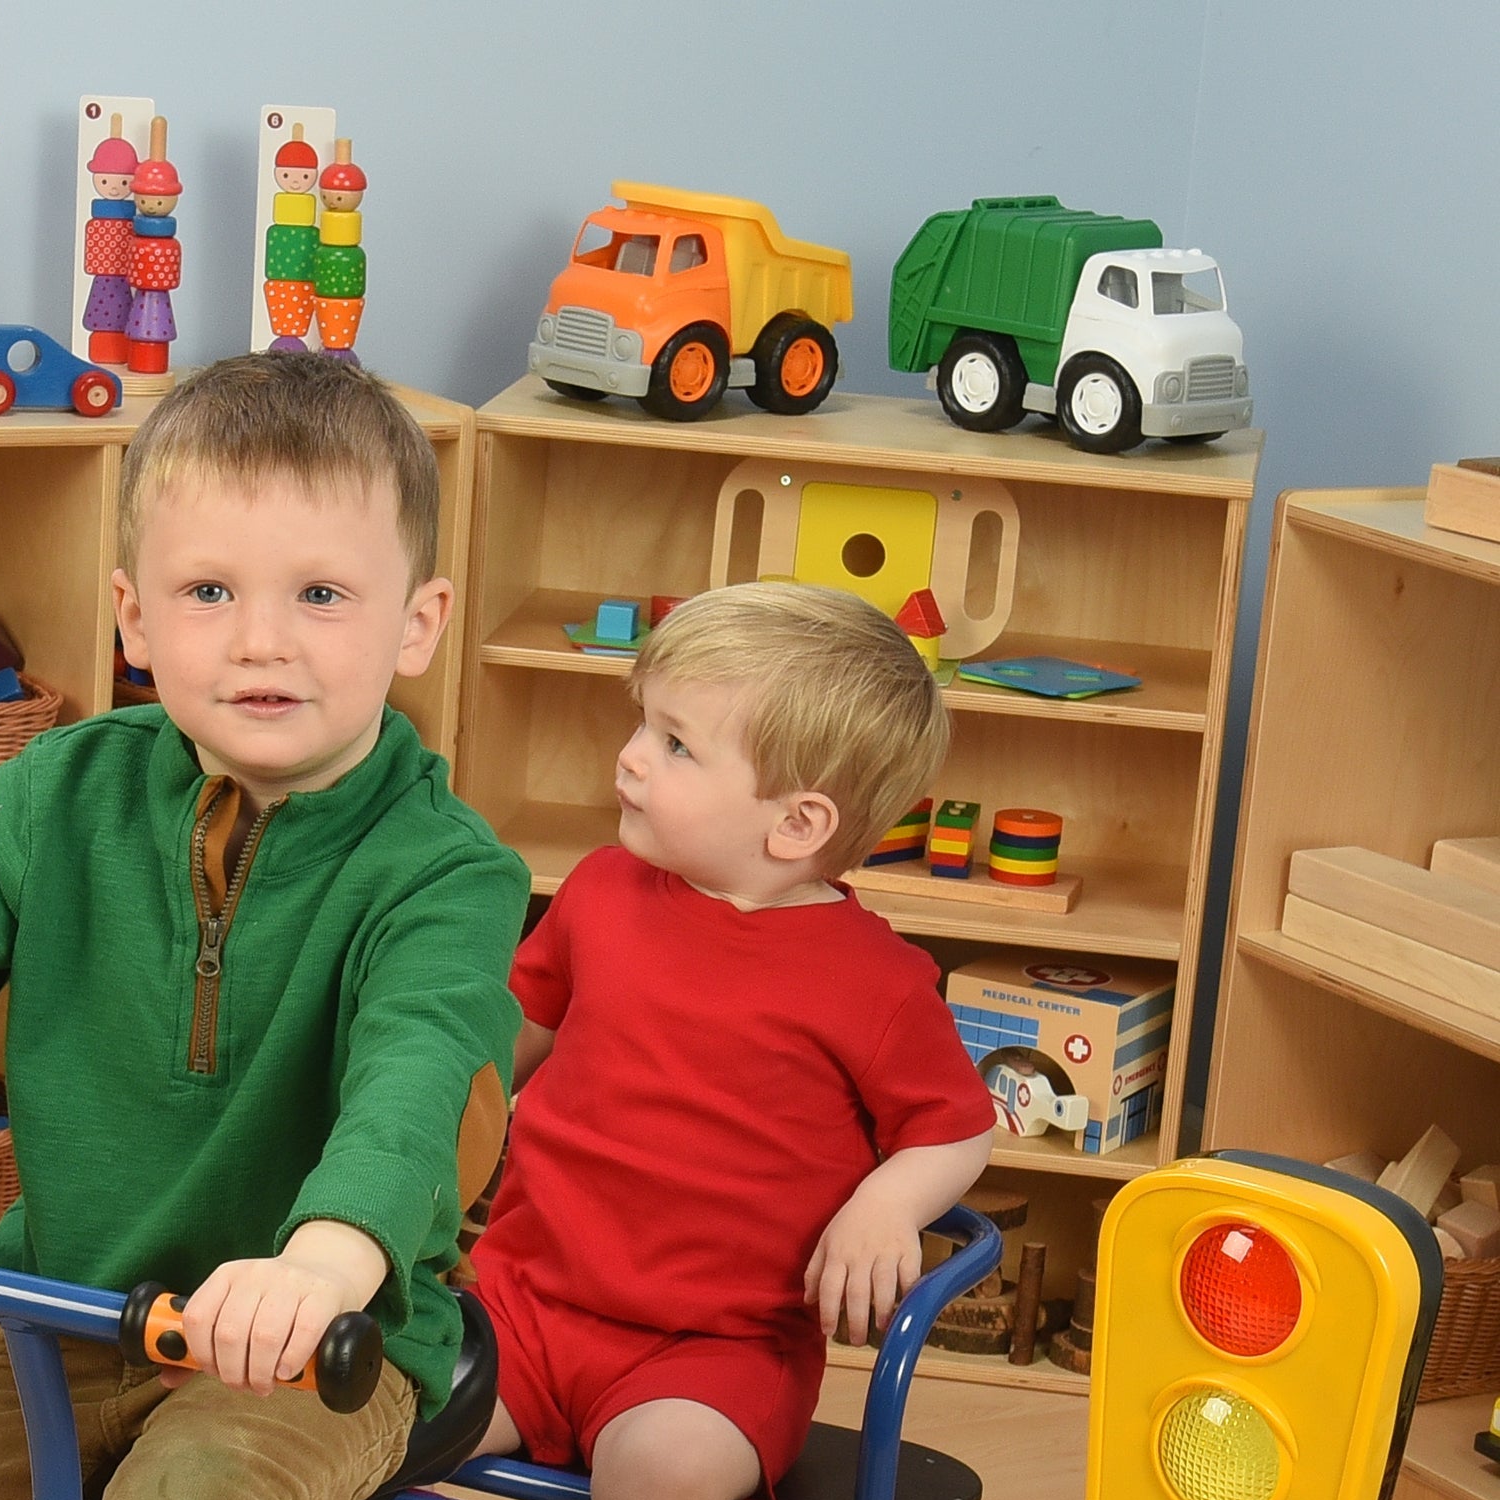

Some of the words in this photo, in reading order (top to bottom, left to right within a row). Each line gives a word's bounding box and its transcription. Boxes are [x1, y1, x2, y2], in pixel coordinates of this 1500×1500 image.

[89, 105, 97, 117] 1
[271, 115, 279, 126] 6
[982, 989, 1033, 1007] MEDICAL
[1037, 999, 1081, 1016] CENTER
